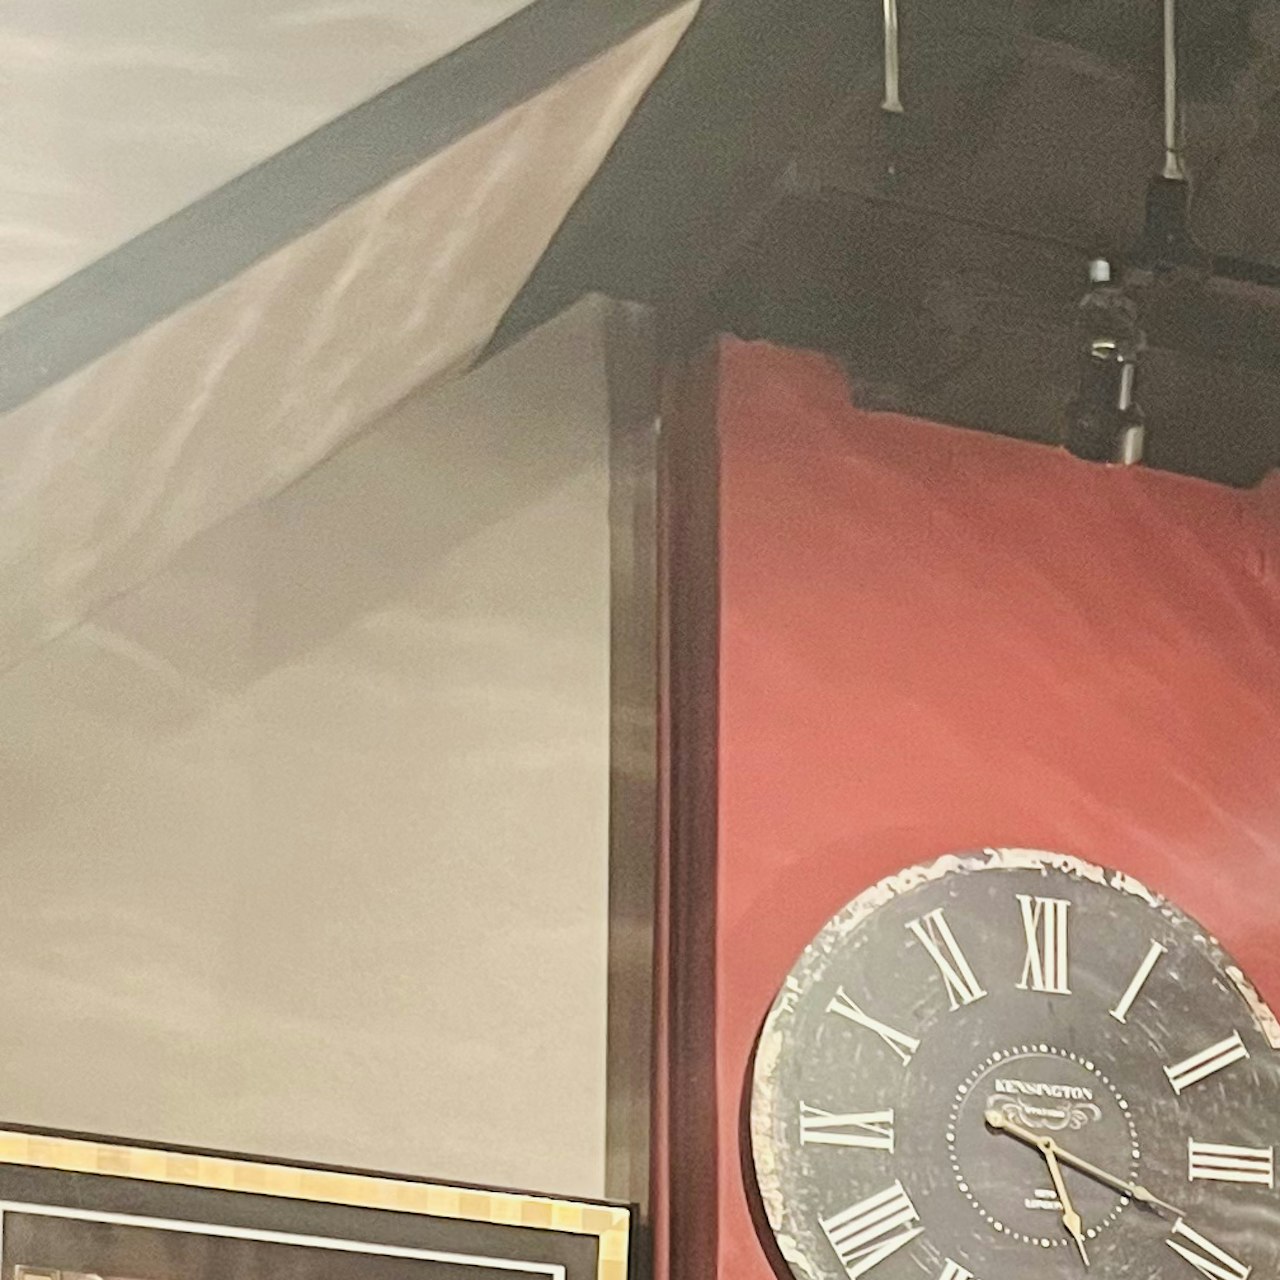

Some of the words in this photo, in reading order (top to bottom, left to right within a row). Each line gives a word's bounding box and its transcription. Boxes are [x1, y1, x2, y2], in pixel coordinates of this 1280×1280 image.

[905, 908, 988, 1012] XI
[1016, 894, 1072, 994] XII
[1109, 940, 1168, 1024] I
[825, 986, 920, 1066] X
[994, 1079, 1093, 1100] KENSINGTON
[1164, 1031, 1250, 1095] II
[800, 1101, 894, 1153] IX
[1188, 1138, 1274, 1188] III
